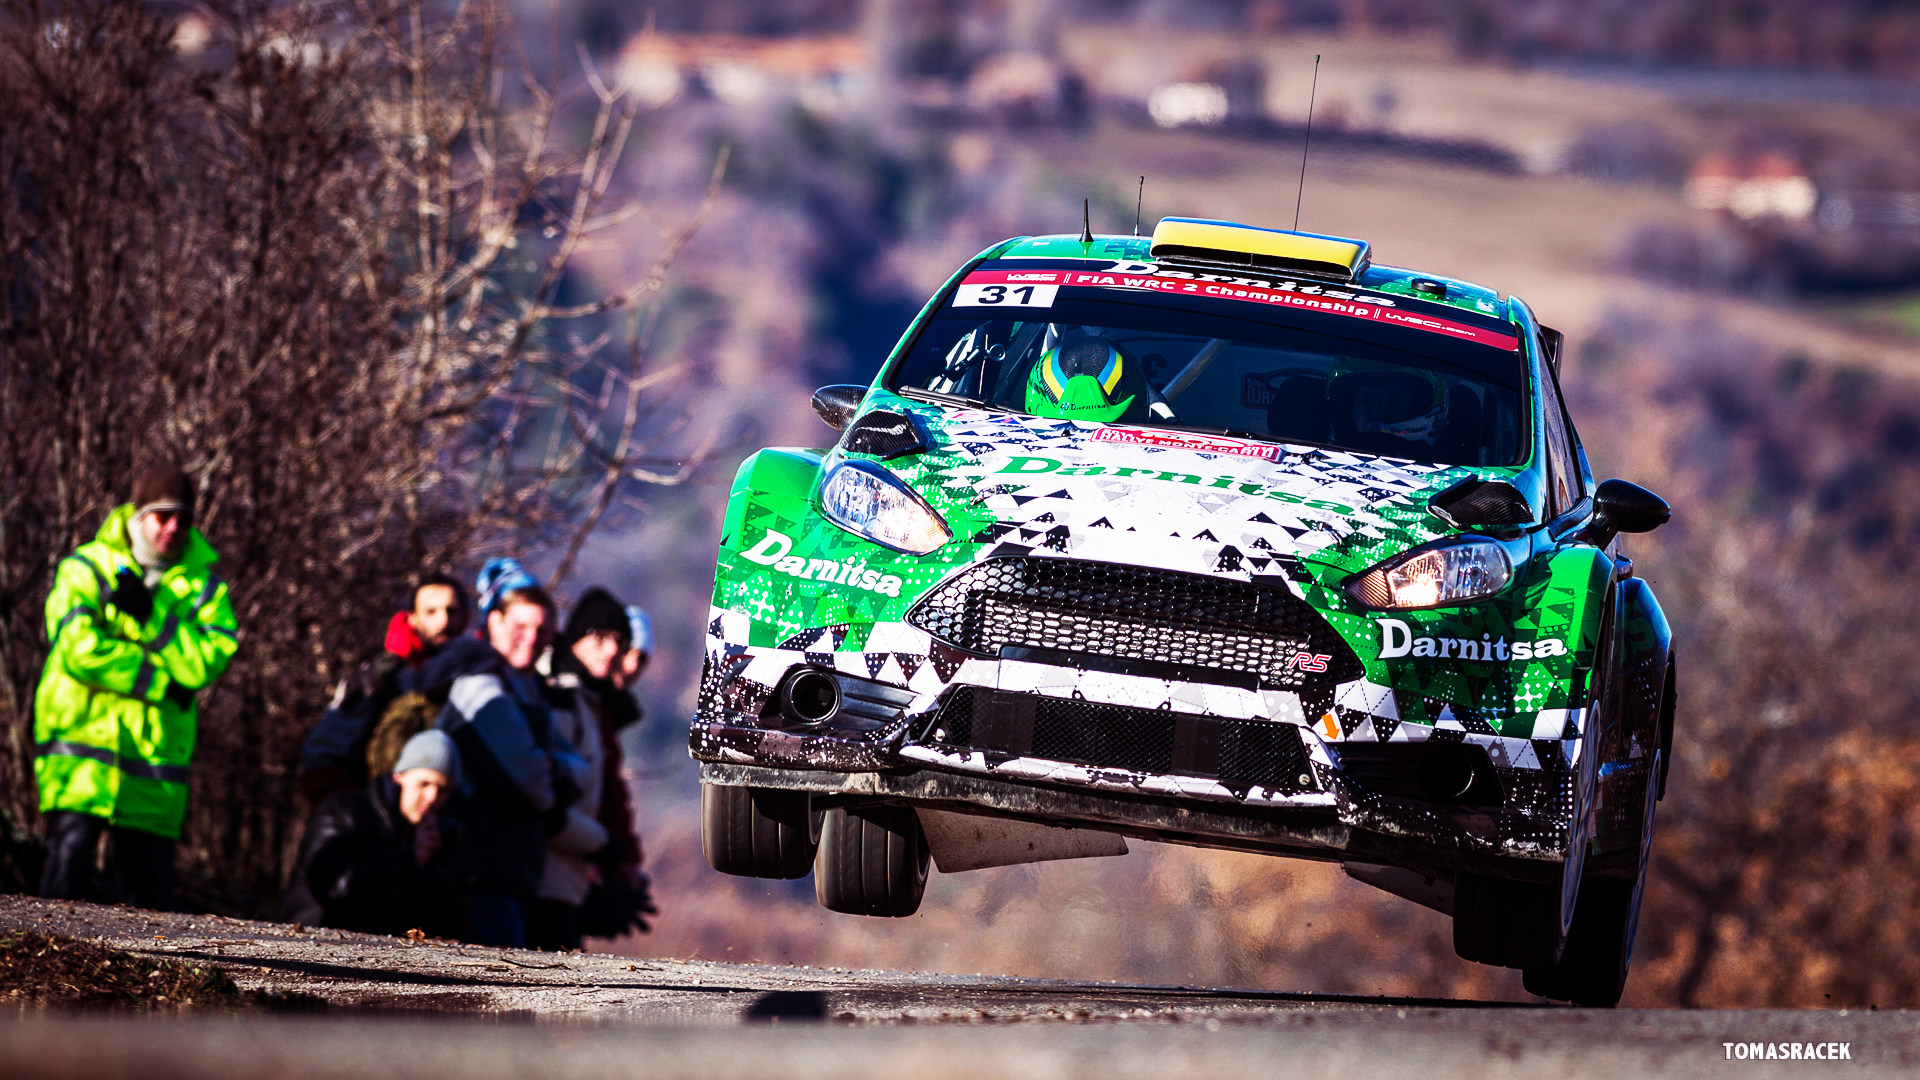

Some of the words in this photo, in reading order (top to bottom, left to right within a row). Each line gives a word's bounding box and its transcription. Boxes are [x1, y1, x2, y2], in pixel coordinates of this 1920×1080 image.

[978, 286, 1035, 304] 31
[1077, 275, 1115, 285] FIA
[1123, 278, 1176, 290] WRC
[1182, 283, 1198, 292] 2
[1205, 285, 1369, 316] Championship
[1101, 259, 1396, 307] Darnitsa
[994, 456, 1355, 517] Darnitsa
[739, 528, 903, 598] Darnitsa
[1375, 618, 1568, 661] Darnitsa
[1288, 652, 1332, 673] RS
